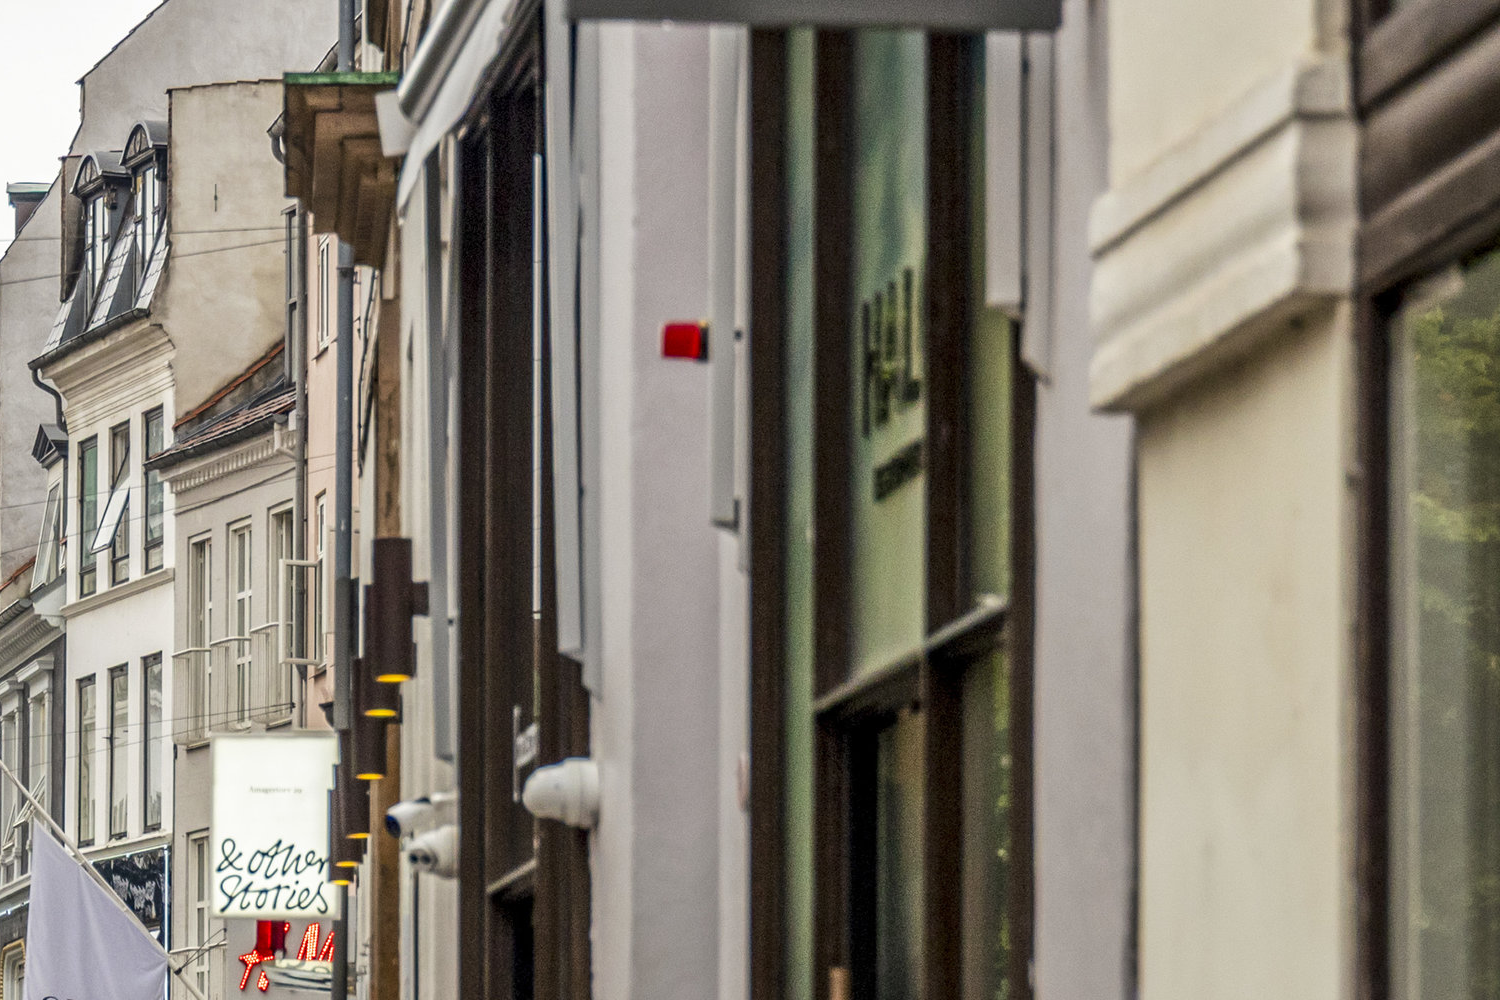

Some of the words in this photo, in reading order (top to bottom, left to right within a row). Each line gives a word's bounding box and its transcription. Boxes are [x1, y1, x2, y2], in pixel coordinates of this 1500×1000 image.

[216, 838, 243, 872] &
[247, 839, 329, 879] other
[219, 874, 329, 914] Stories
